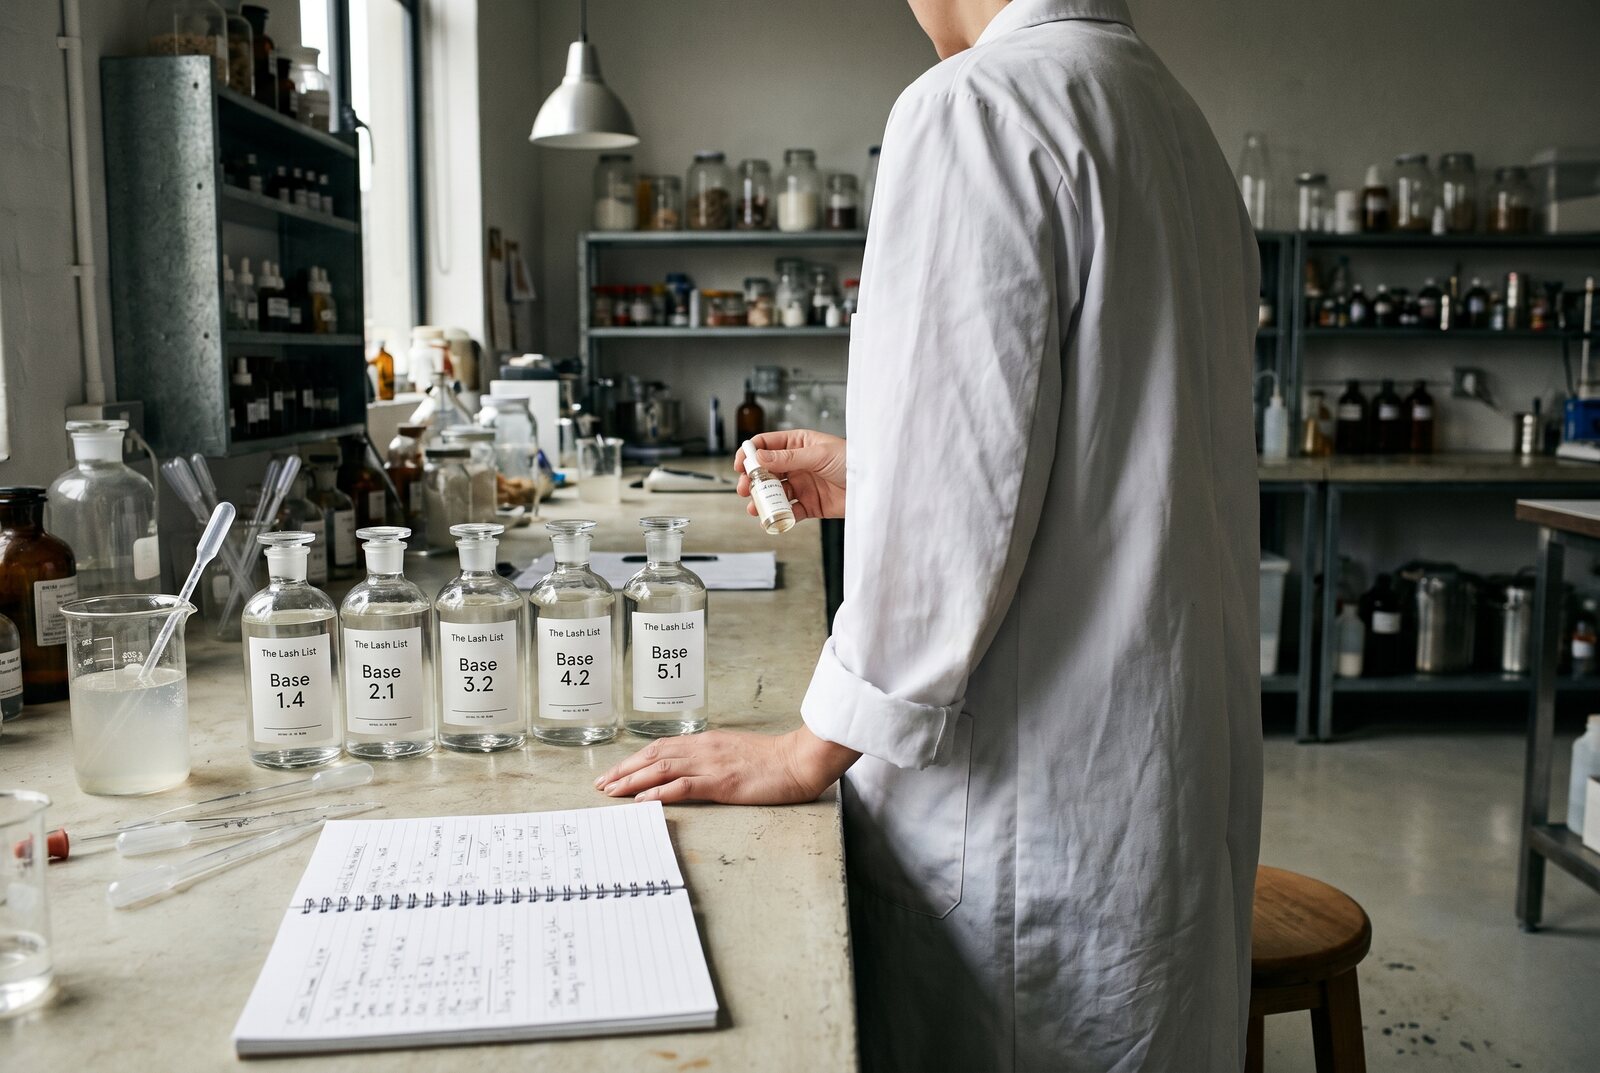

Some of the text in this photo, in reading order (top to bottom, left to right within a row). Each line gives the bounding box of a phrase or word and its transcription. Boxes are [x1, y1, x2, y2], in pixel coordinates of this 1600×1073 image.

[549, 628, 601, 638] The Lash List
[644, 622, 695, 631] The Lash List
[354, 640, 408, 649] The Lash List
[451, 633, 504, 643] The Lash List
[262, 648, 317, 658] The Lash List
[556, 652, 594, 666] Base
[652, 646, 688, 659] Base
[362, 664, 401, 679] Base
[459, 658, 498, 672] Base
[657, 663, 681, 679] 5.1
[270, 673, 310, 687] Base
[463, 675, 494, 692] 3.2
[560, 669, 590, 686] 4.2
[369, 683, 394, 700] 2.1
[276, 691, 305, 709] 1.4
